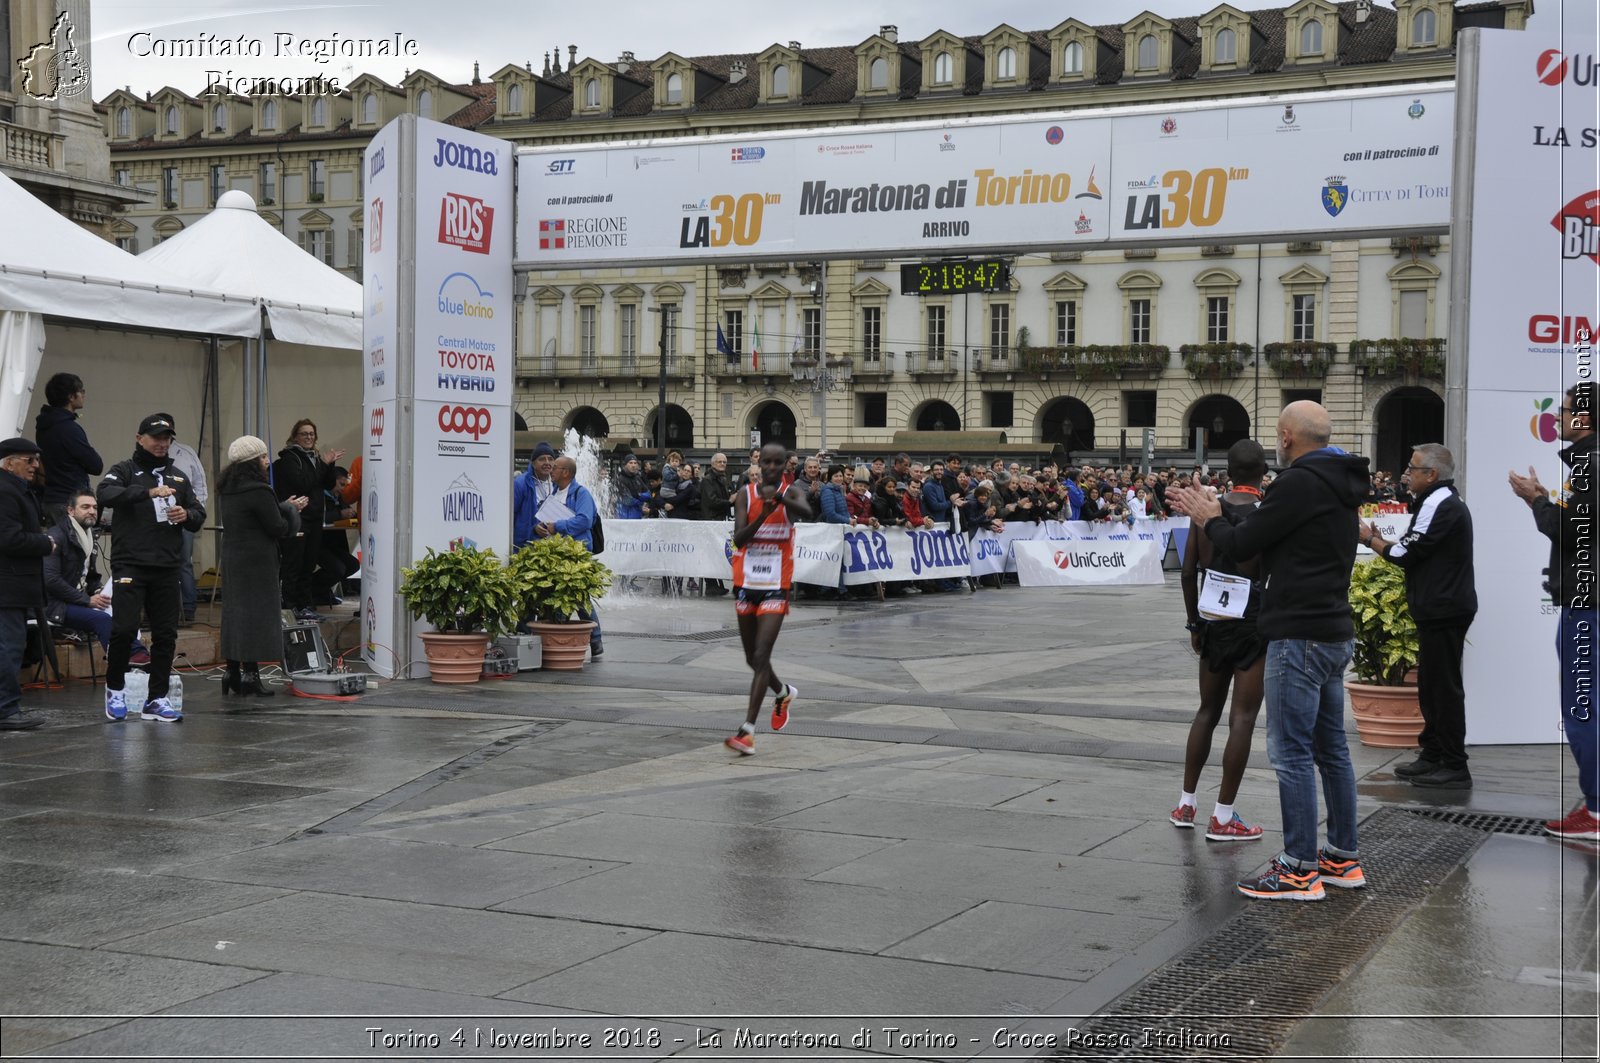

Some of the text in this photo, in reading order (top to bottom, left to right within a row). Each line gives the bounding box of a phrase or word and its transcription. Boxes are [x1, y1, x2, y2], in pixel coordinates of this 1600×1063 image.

[1533, 126, 1600, 149] LA S
[1343, 145, 1439, 162] con il patrocinio di
[547, 193, 613, 206] con il patrocinio di
[799, 168, 1072, 216] Maratona di Torino
[1124, 166, 1249, 231] LA 30 km
[1398, 189, 1410, 202] DI
[445, 196, 484, 241] RDS
[567, 217, 628, 234] REGIONE
[680, 192, 781, 249] LA 30 km
[923, 220, 970, 238] ARRIVO
[567, 232, 628, 249] PIEMONTE
[920, 263, 999, 290] 2:18:47
[438, 297, 494, 319] bluetorino
[438, 335, 496, 353] Central Motors
[438, 350, 495, 371] TOYOTA
[438, 373, 495, 393] HYBRID
[438, 405, 491, 441] coop
[437, 443, 466, 454] Novacoop
[442, 491, 484, 522] VALMORA
[1374, 525, 1397, 536] redit
[641, 543, 652, 553] DI
[657, 540, 695, 554] TORINO
[796, 546, 840, 563] TORINO
[1070, 551, 1126, 568] UniCredit
[1218, 590, 1230, 608] 4
